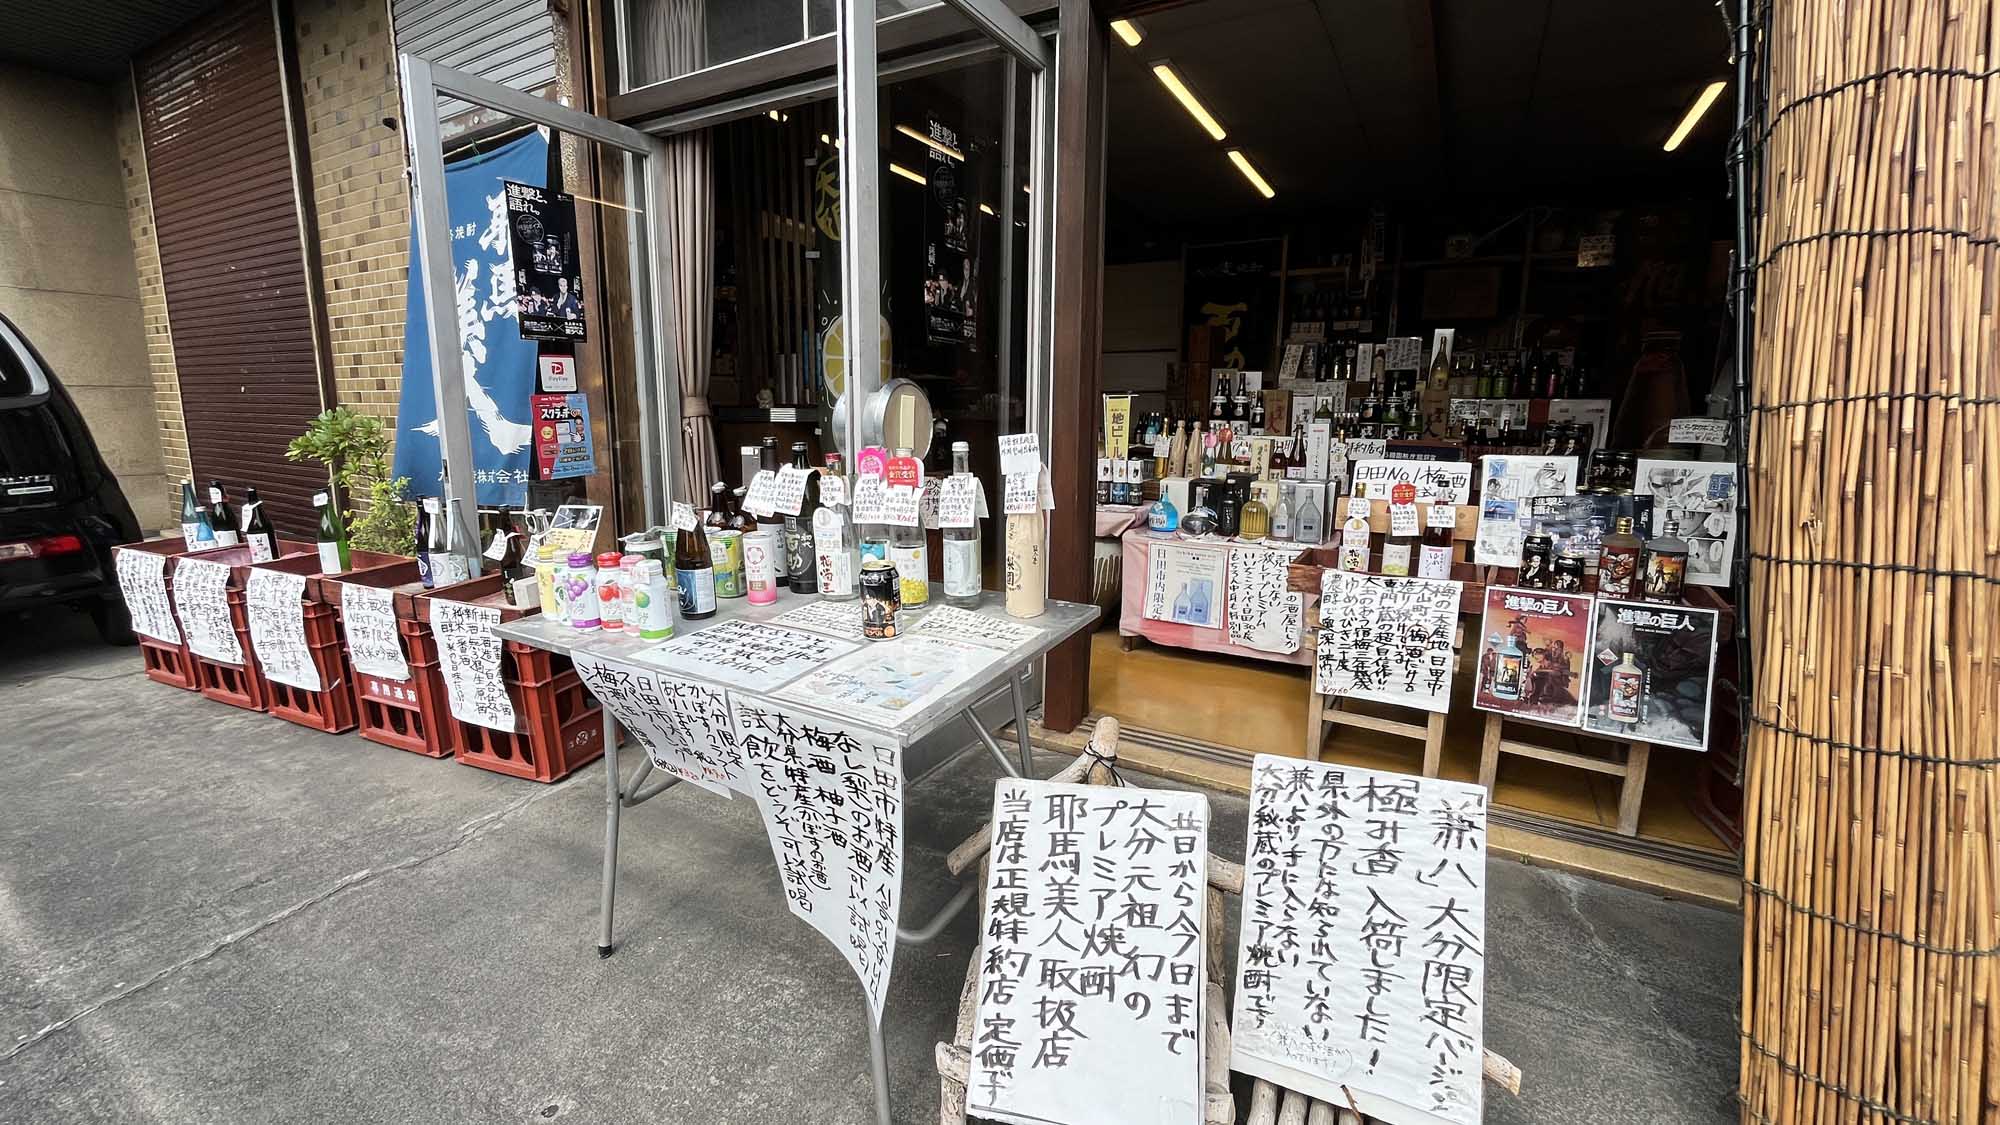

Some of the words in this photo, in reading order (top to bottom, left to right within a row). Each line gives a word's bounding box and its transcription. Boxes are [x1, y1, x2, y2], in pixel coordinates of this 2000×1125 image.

[1504, 594, 1574, 617] 進撃の巨人
[1617, 607, 1696, 632] 進撃の巨人
[872, 744, 901, 880] 日田市特産
[1078, 799, 1130, 1004] プレミア焼酎
[1160, 809, 1204, 1057] 昔から今日まで
